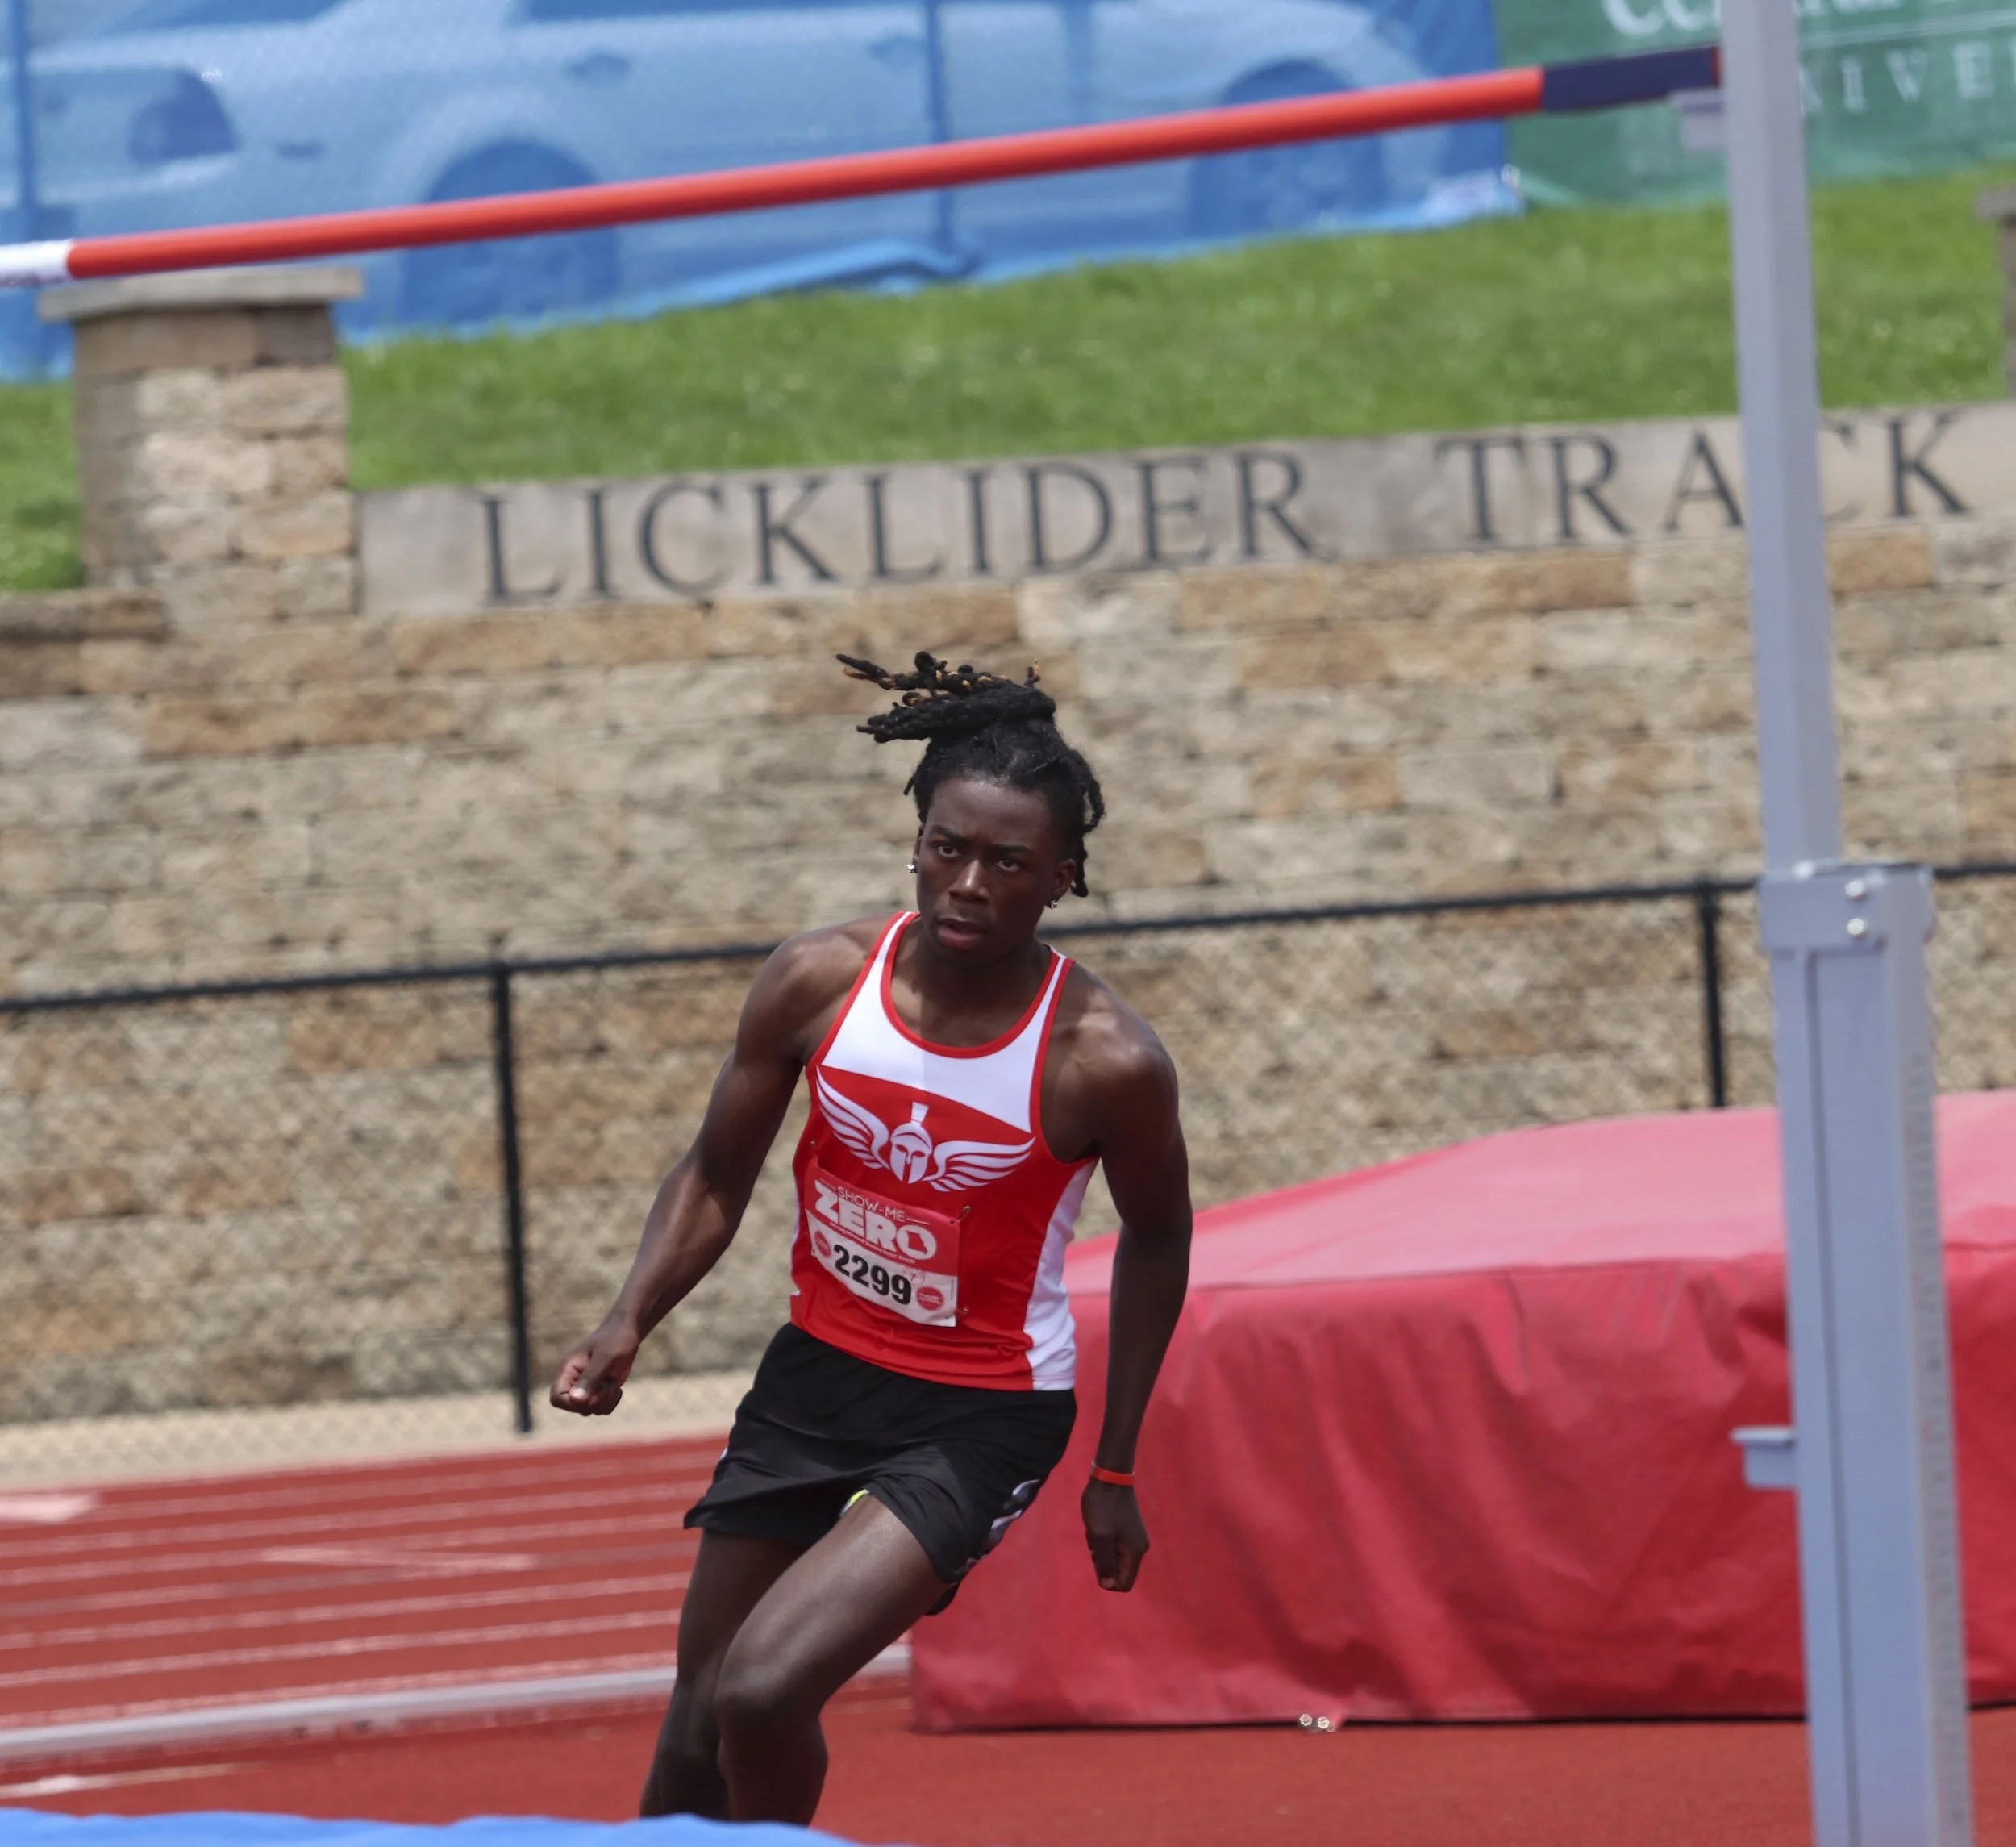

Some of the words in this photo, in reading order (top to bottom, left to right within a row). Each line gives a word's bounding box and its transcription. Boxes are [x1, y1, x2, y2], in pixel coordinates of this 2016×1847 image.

[479, 448, 1334, 603] LICKLIDER
[814, 1179, 937, 1261] ZERO
[837, 1186, 906, 1223] SHOW-ME
[833, 1244, 912, 1306] 2299
